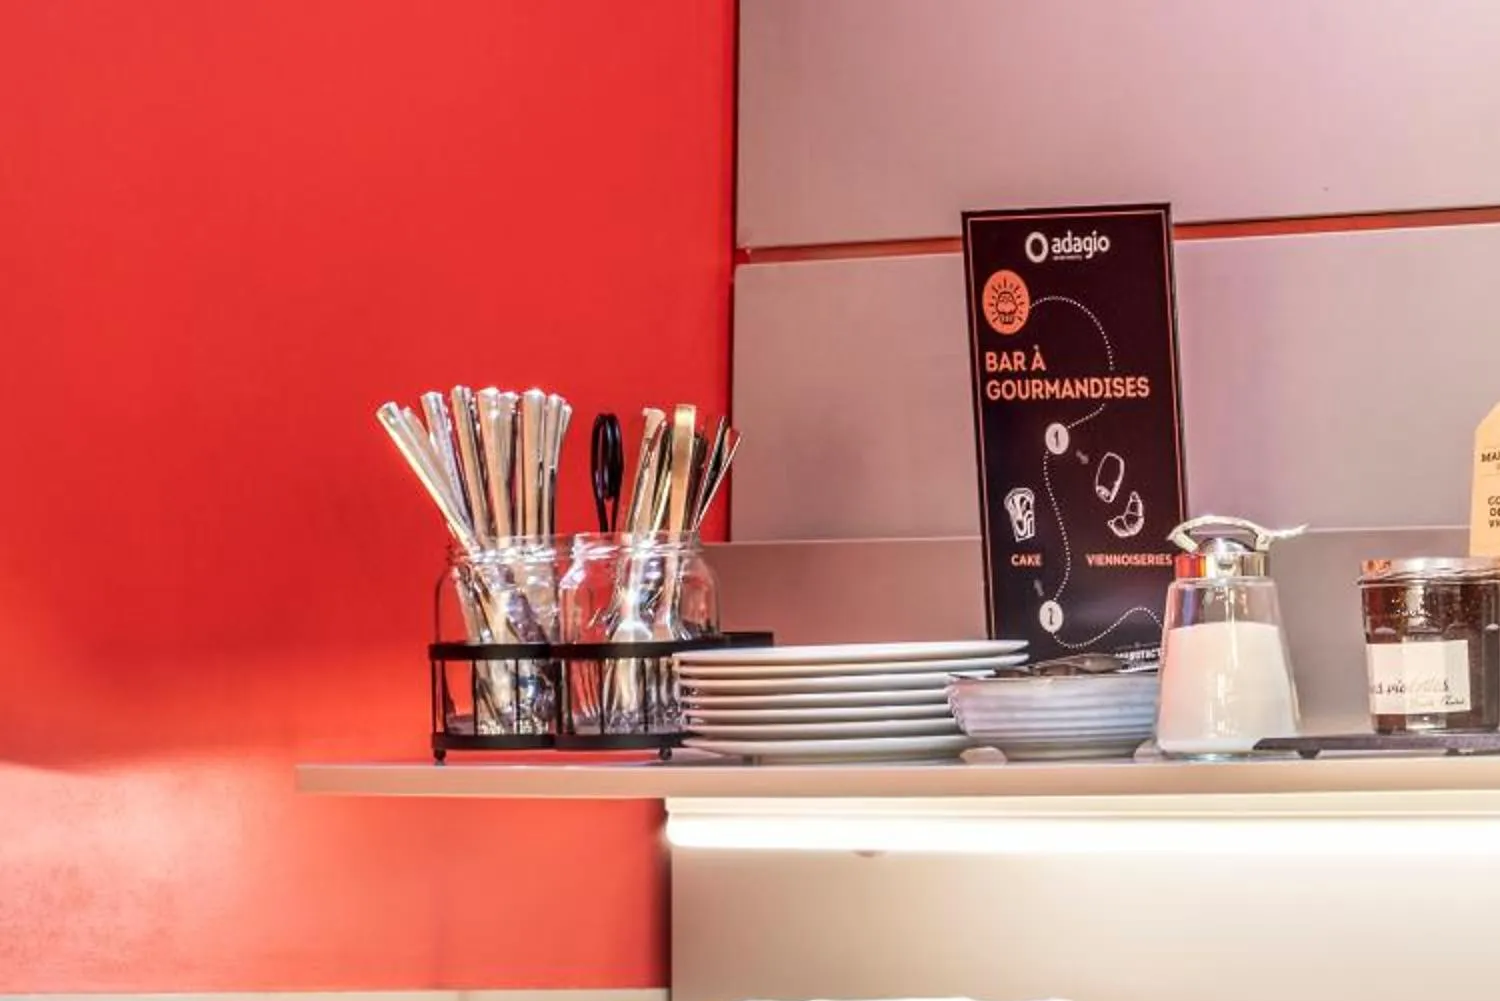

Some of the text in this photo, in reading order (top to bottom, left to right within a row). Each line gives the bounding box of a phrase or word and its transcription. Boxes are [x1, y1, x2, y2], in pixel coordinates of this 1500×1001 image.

[1051, 230, 1110, 259] adagio
[985, 344, 1047, 373] BAR À
[986, 376, 1150, 401] GOURMANDISES
[1011, 554, 1041, 567] CAKE
[1086, 553, 1172, 567] VIENNOISERIES
